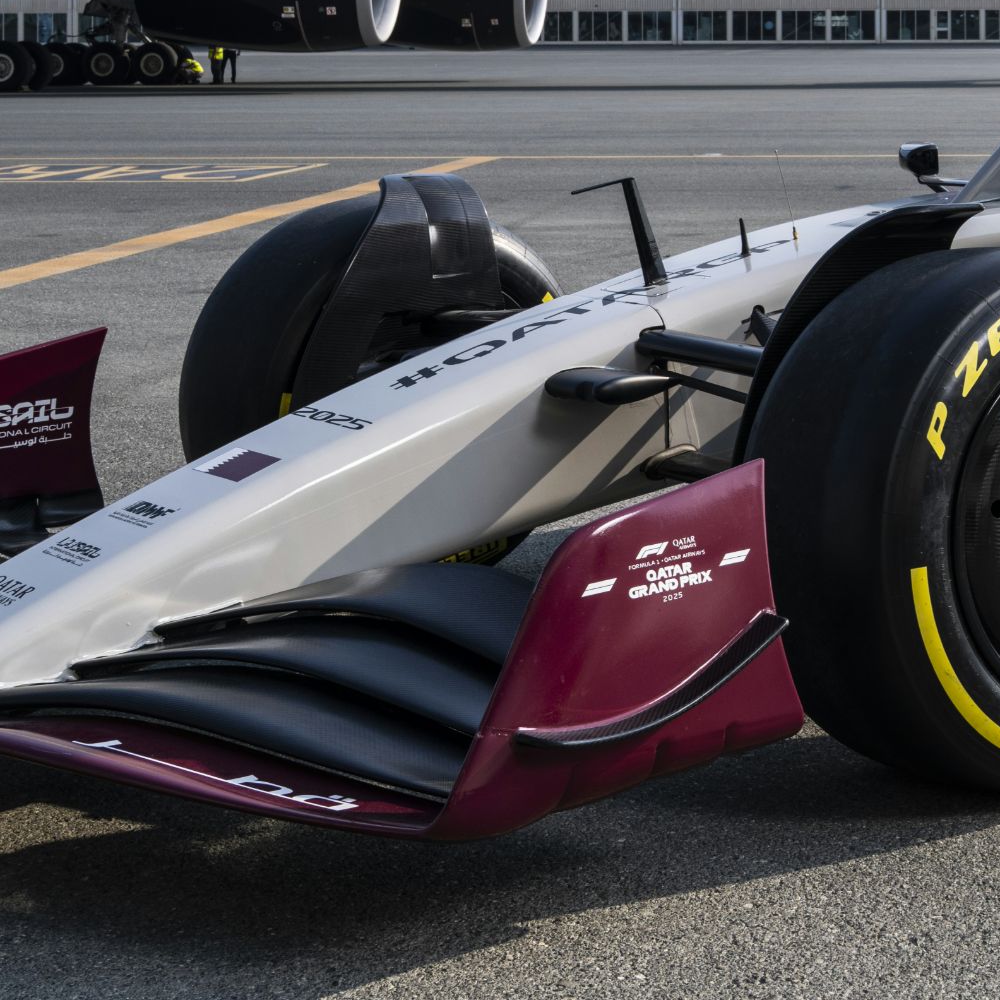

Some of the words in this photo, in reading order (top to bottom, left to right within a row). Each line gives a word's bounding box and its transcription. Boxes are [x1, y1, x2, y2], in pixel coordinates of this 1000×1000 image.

[31, 421, 72, 434] CIRCUIT
[291, 406, 373, 430] 2025
[926, 401, 948, 461] P
[672, 535, 696, 547] QATAR
[645, 561, 693, 582] QATAR
[628, 578, 679, 599] GRAND
[681, 569, 713, 588] PRIX
[662, 591, 683, 603] 2025
